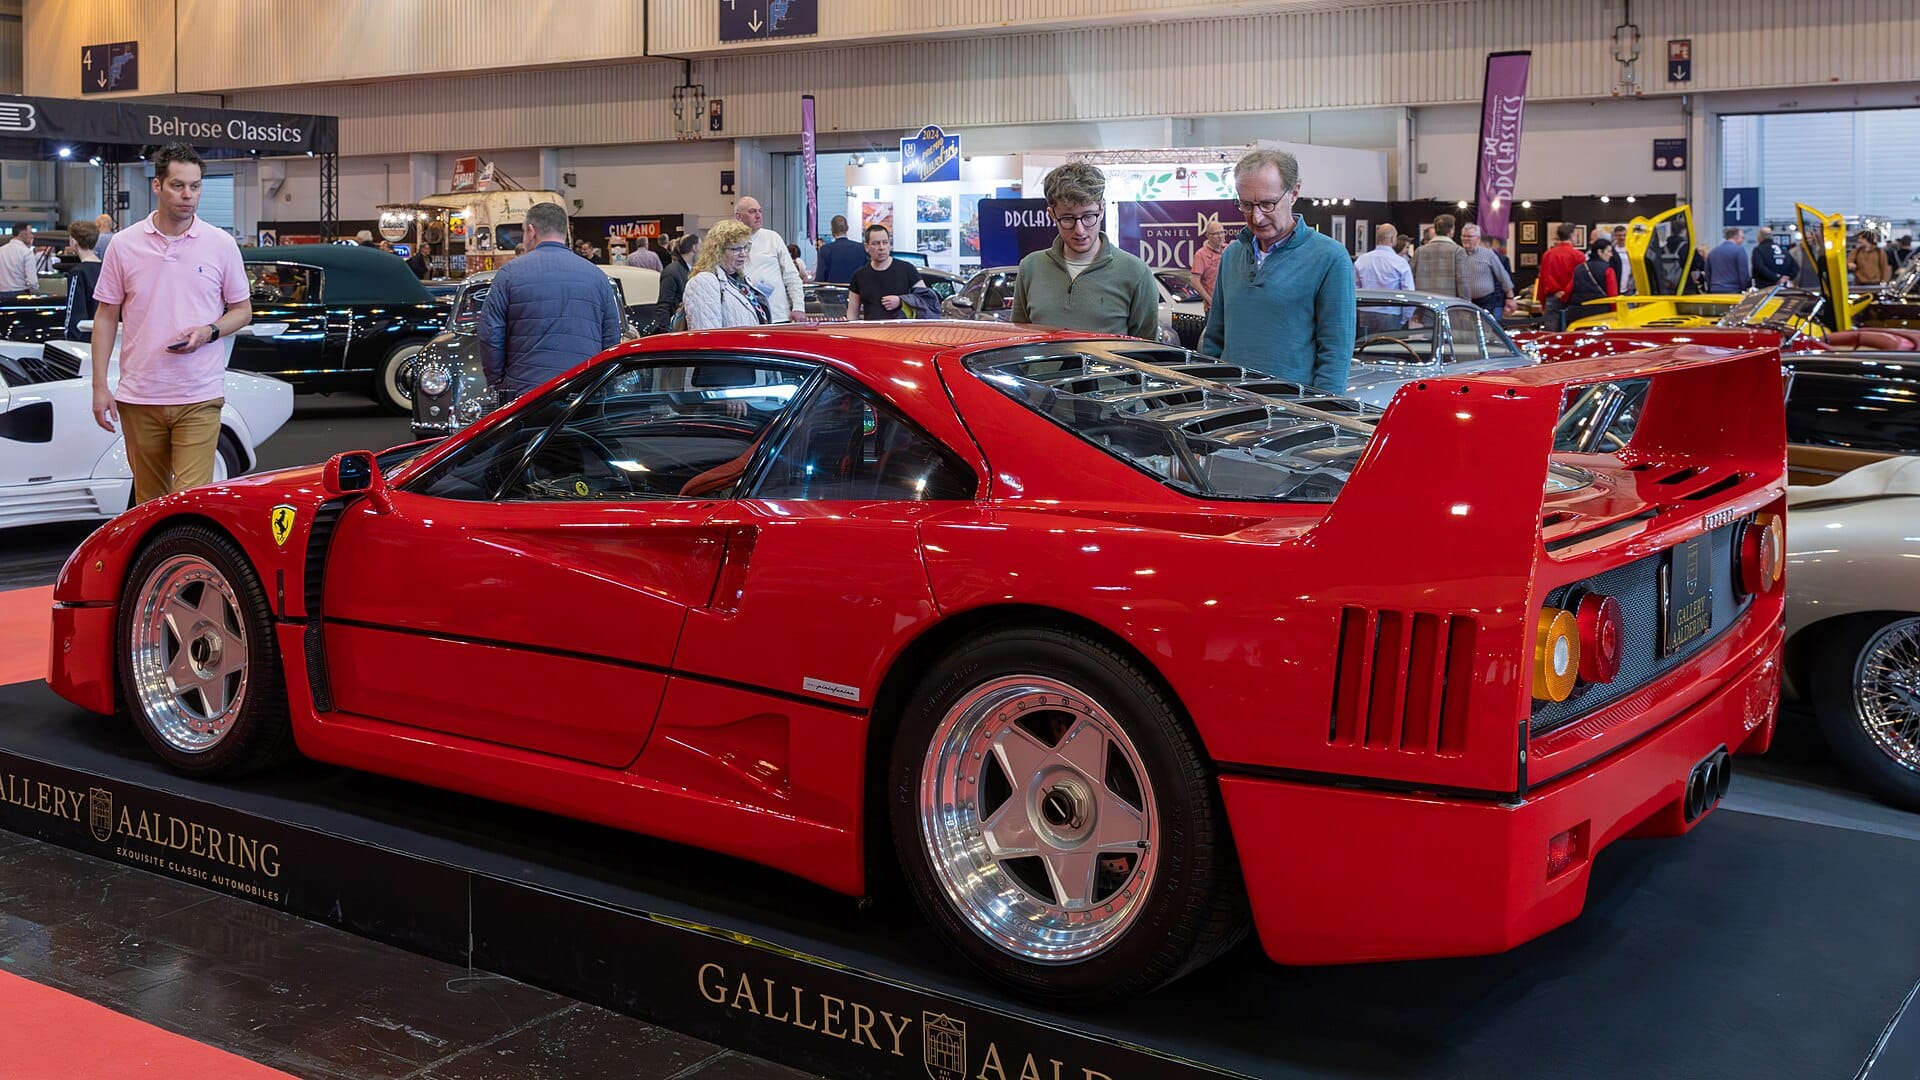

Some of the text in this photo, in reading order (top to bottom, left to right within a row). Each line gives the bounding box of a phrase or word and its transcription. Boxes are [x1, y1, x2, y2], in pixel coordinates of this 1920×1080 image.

[83, 49, 93, 72] 4
[149, 114, 302, 143] Belrose Classics
[922, 129, 939, 140] 2024
[1495, 95, 1521, 200] DDCLASSICS
[1725, 192, 1744, 221] 4
[609, 222, 656, 238] CINZANO
[1147, 229, 1191, 238] DANIEL
[1676, 595, 1706, 626] GALLERY
[117, 805, 281, 878] AALDERING
[116, 846, 280, 902] EXQUISITE CLASSIC AUTOMOBILES
[697, 962, 913, 1057] GALLERY
